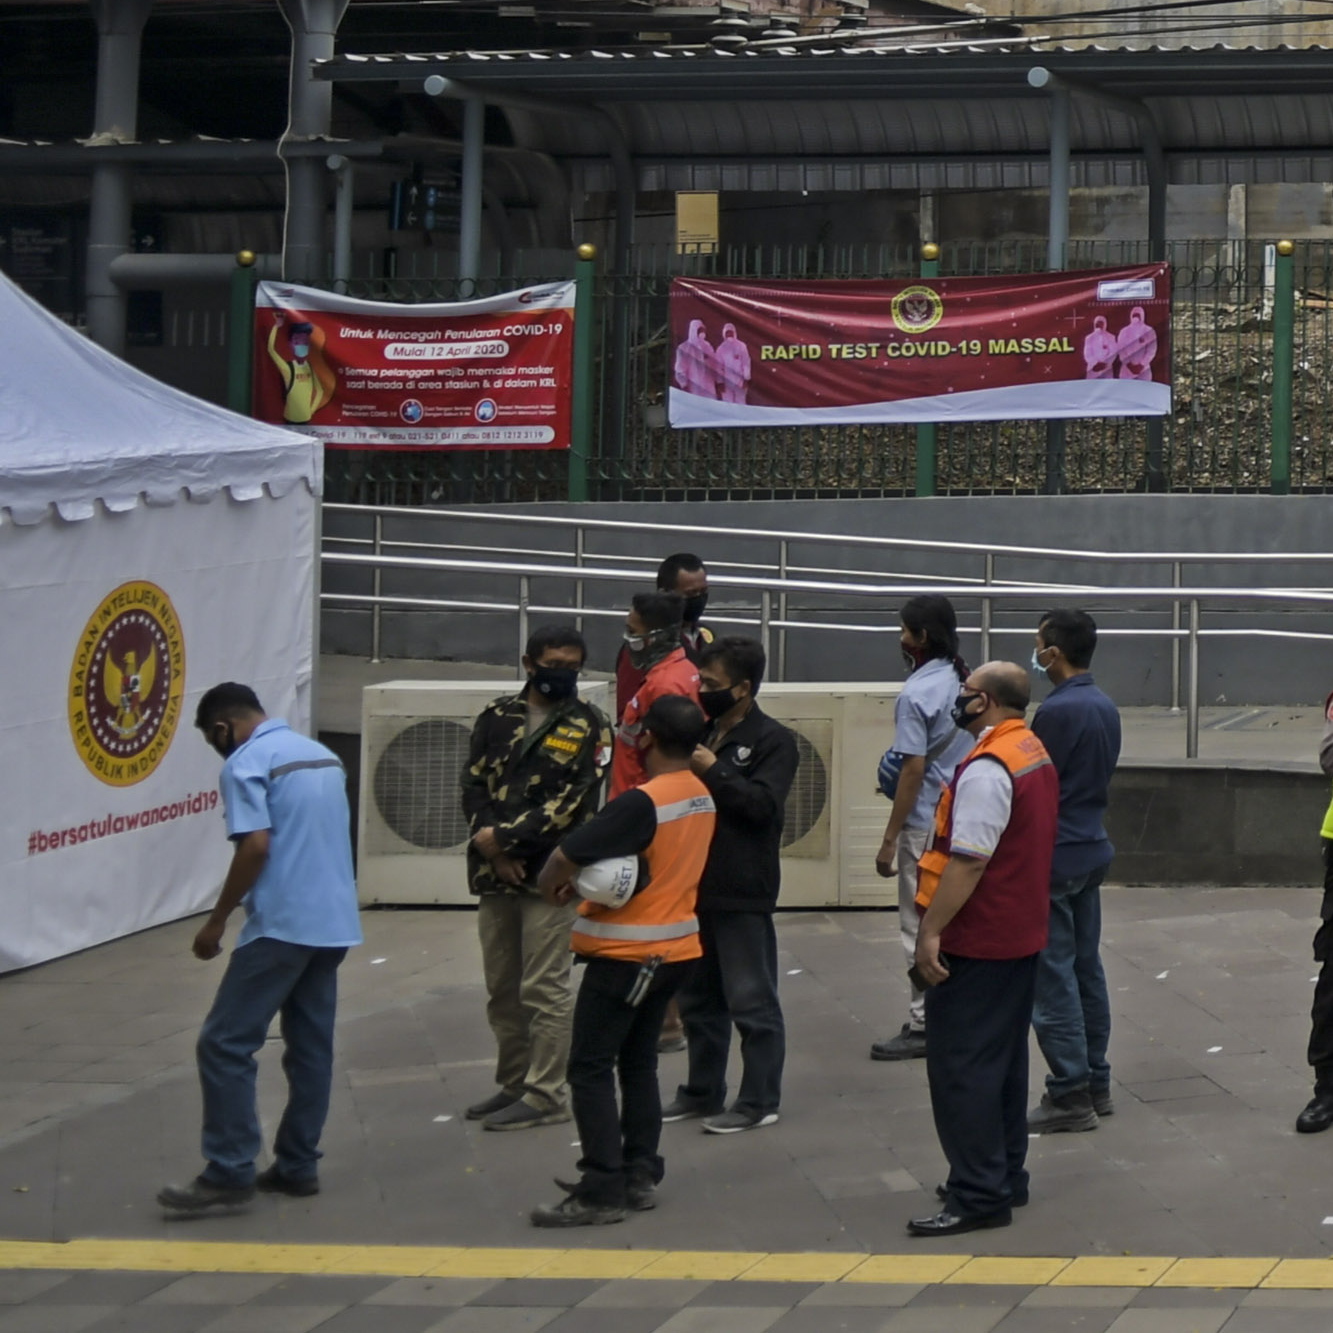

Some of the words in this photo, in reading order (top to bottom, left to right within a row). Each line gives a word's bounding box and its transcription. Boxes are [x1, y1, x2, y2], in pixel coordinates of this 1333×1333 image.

[339, 327, 373, 339] Untuk
[376, 329, 442, 342] Mencegah
[444, 328, 501, 340] Penularan
[503, 323, 563, 336] COVID-19
[392, 346, 427, 357] Mulai
[430, 346, 444, 356] 12
[446, 345, 471, 358] April
[473, 343, 505, 355] 2020
[760, 343, 822, 361] RAPID
[827, 342, 881, 359] TEST
[886, 340, 982, 358] COVID-19
[988, 338, 1075, 355] MASSAL
[345, 367, 378, 377] Semua
[379, 367, 434, 379] pelanggan
[437, 366, 464, 378] wajib
[518, 365, 554, 375] masker
[367, 379, 403, 389] berada
[405, 379, 415, 389] di
[417, 381, 442, 389] area
[444, 379, 480, 389] stasiun
[483, 379, 491, 389] &
[493, 379, 502, 388] di
[504, 378, 537, 388] dalam
[539, 377, 556, 387] KRL
[73, 626, 99, 697] BADAN
[98, 589, 159, 624] INTELIJEN
[159, 603, 182, 681] NEGARA
[74, 710, 124, 780] REPUBLIK
[126, 694, 181, 778] INDONESIA
[27, 789, 219, 856] #bersatulawancovid19
